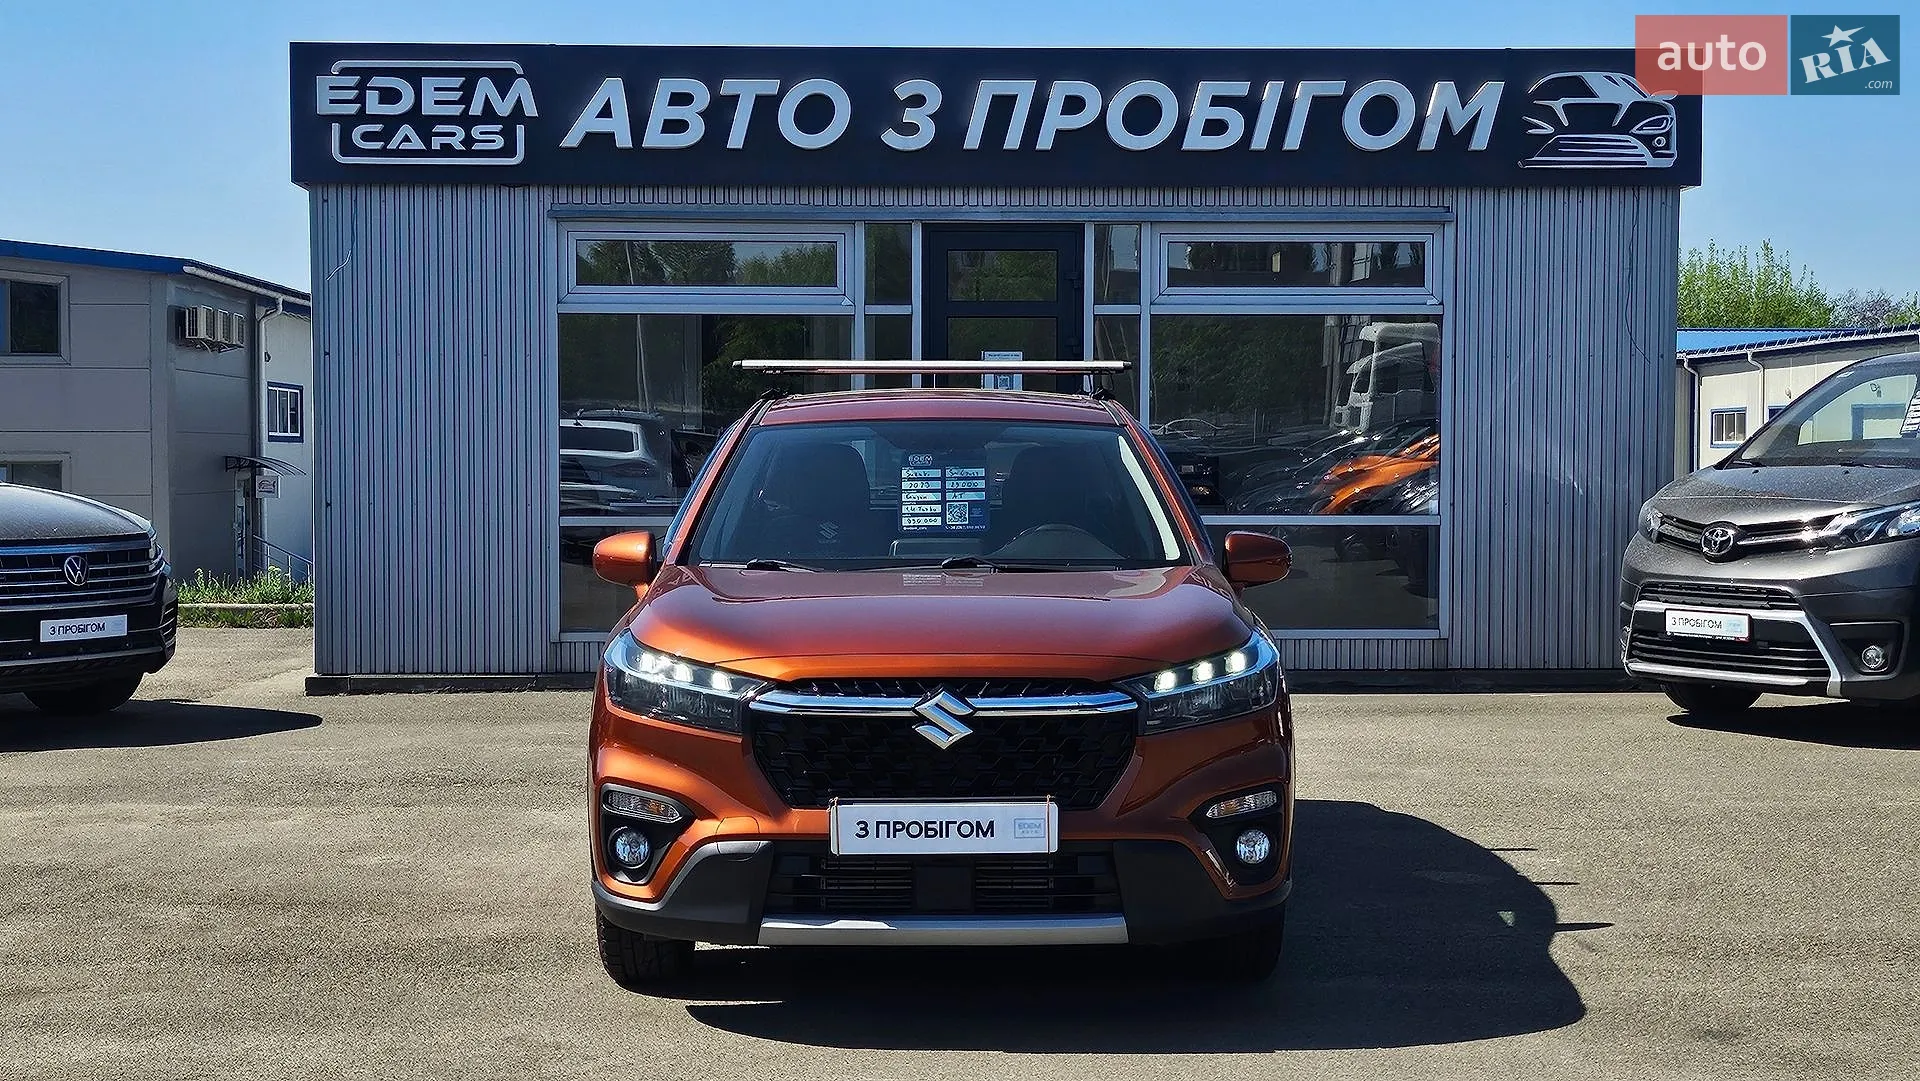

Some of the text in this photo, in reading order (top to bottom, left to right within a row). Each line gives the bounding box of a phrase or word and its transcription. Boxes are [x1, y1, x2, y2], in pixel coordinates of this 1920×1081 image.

[316, 75, 538, 118] EDEM
[560, 77, 852, 150] АВТО
[962, 78, 1506, 152] ПРОБІГОМ
[351, 124, 506, 151] CARS
[58, 622, 106, 635] ПРОБІГОМ
[1678, 617, 1722, 629] ПРОБІГОМ
[876, 819, 995, 839] ПРОБІГОМ
